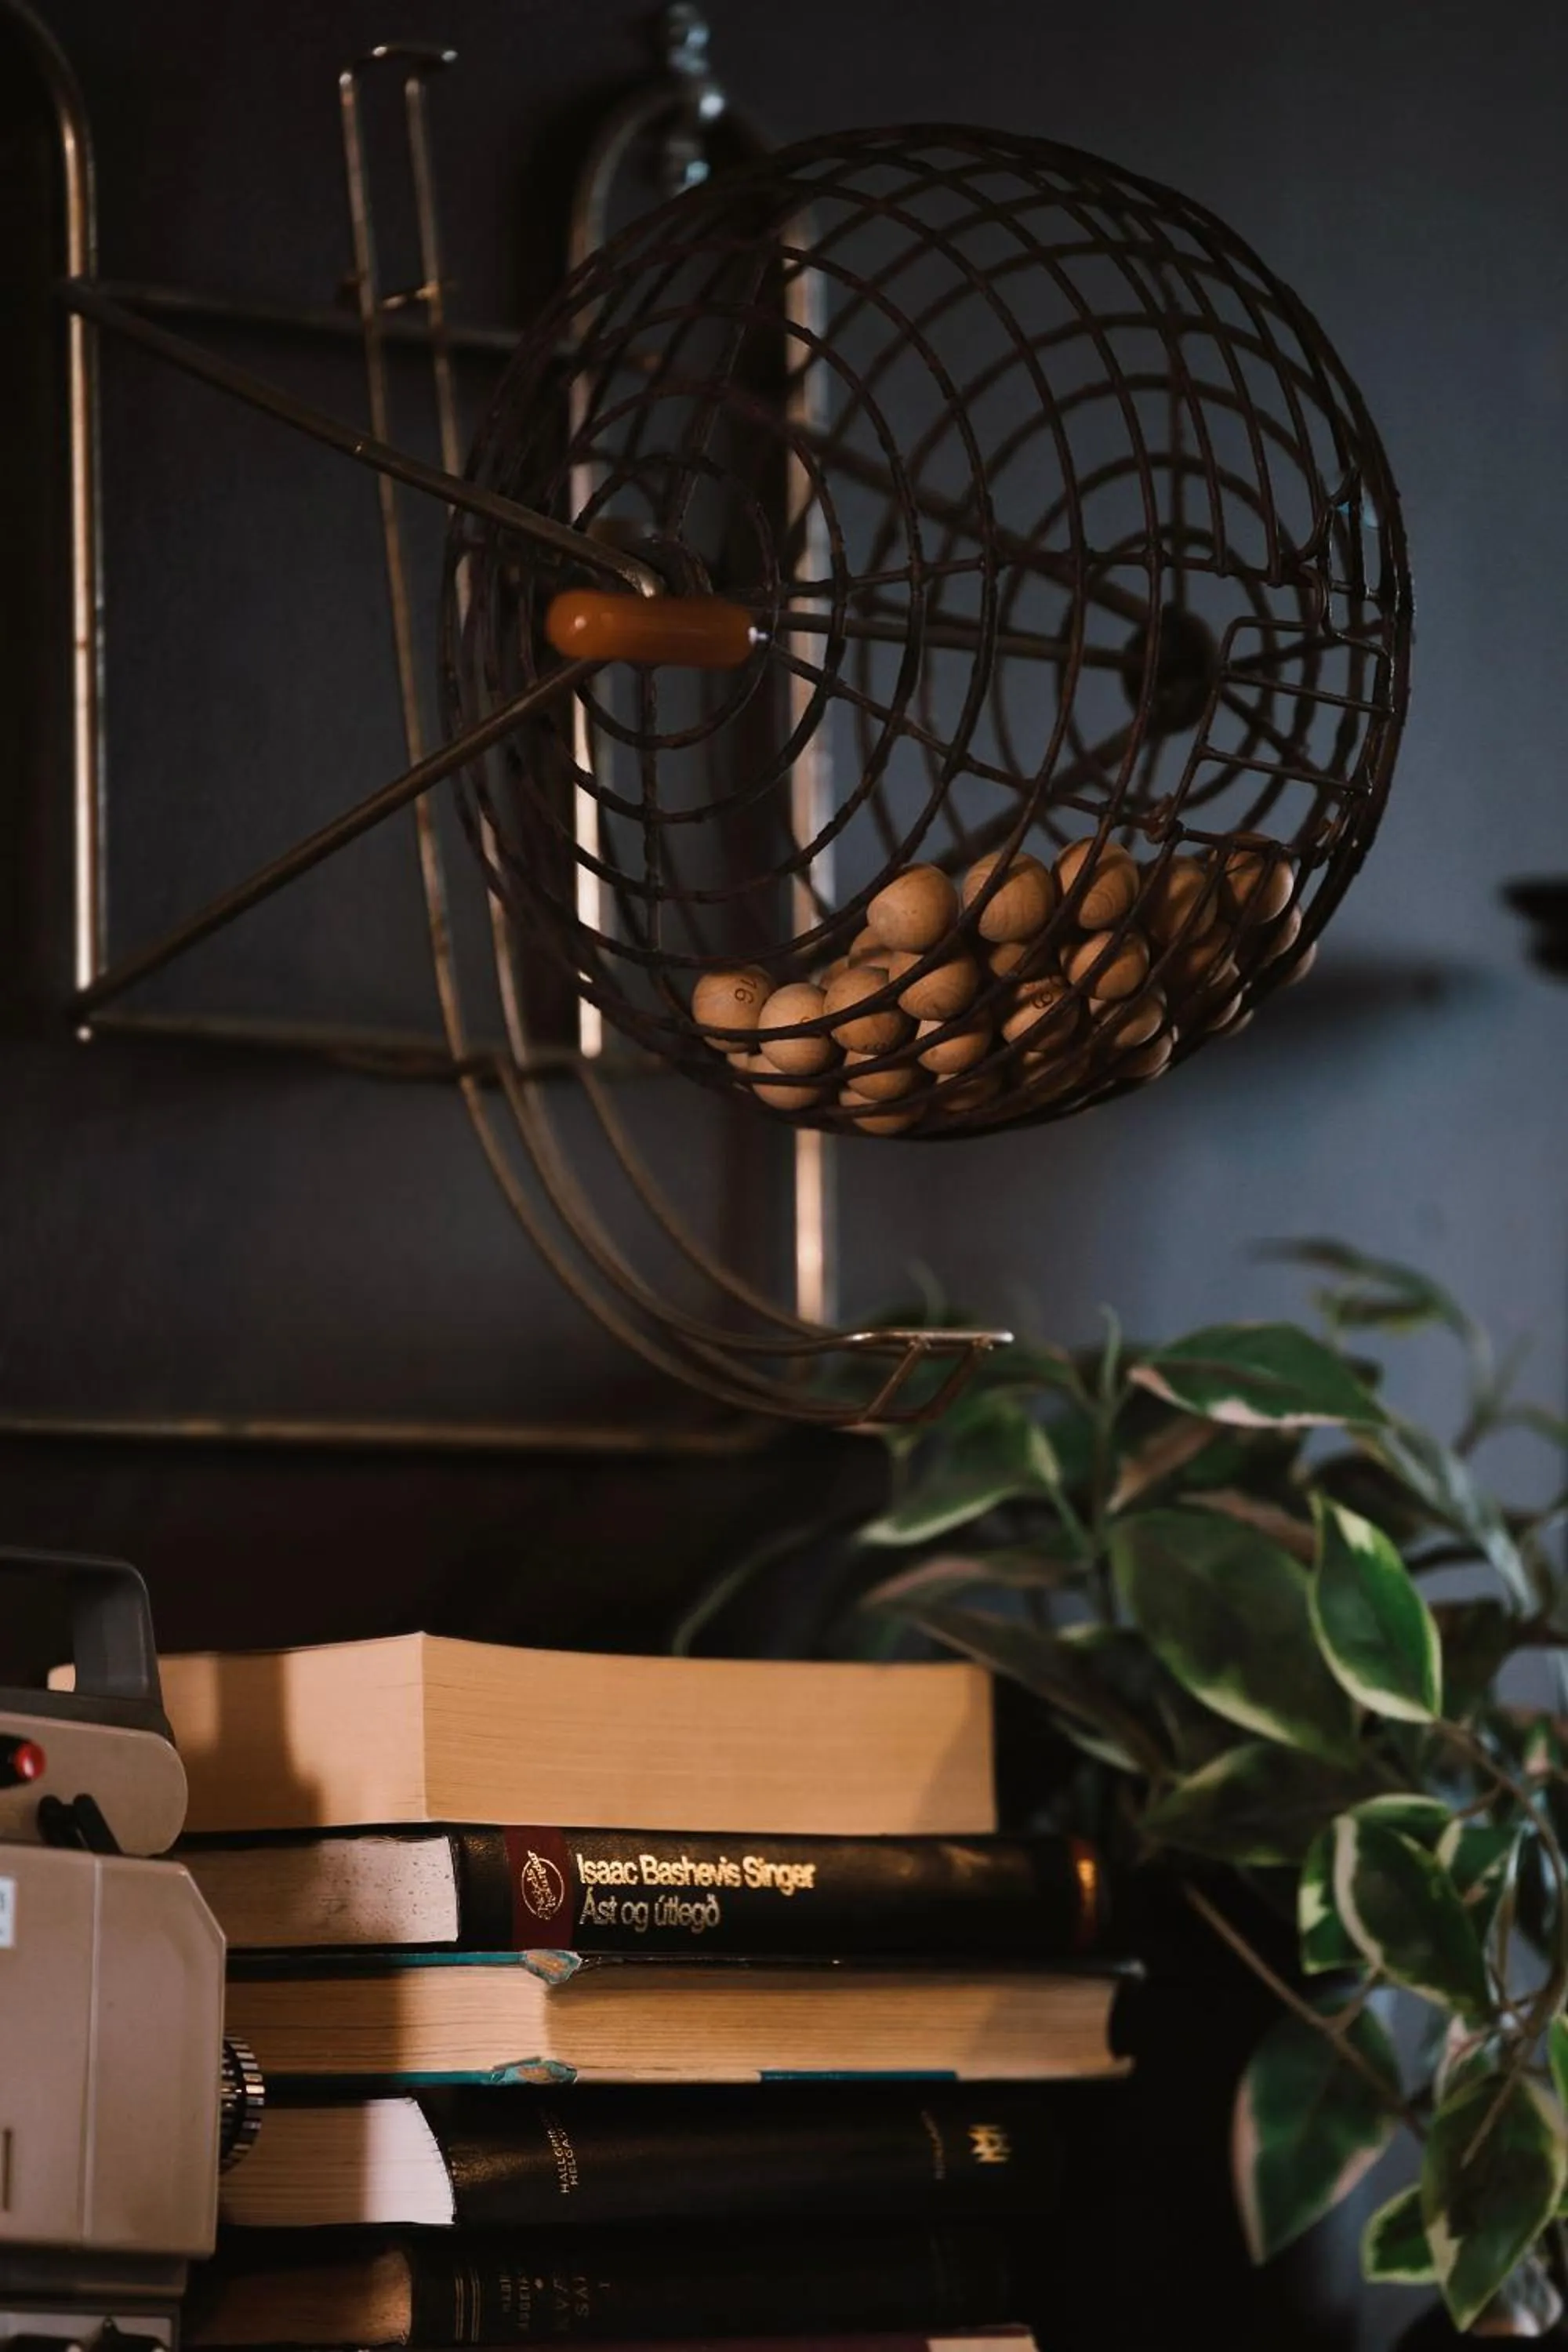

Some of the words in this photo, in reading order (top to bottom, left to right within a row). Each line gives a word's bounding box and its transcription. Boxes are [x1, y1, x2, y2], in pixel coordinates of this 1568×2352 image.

[575, 1853, 639, 1885] Isaac
[639, 1854, 742, 1887] Bashevis
[742, 1856, 816, 1896] Singer
[579, 1886, 617, 1925] Ást
[620, 1900, 649, 1933] og
[654, 1894, 720, 1934] útlegð
